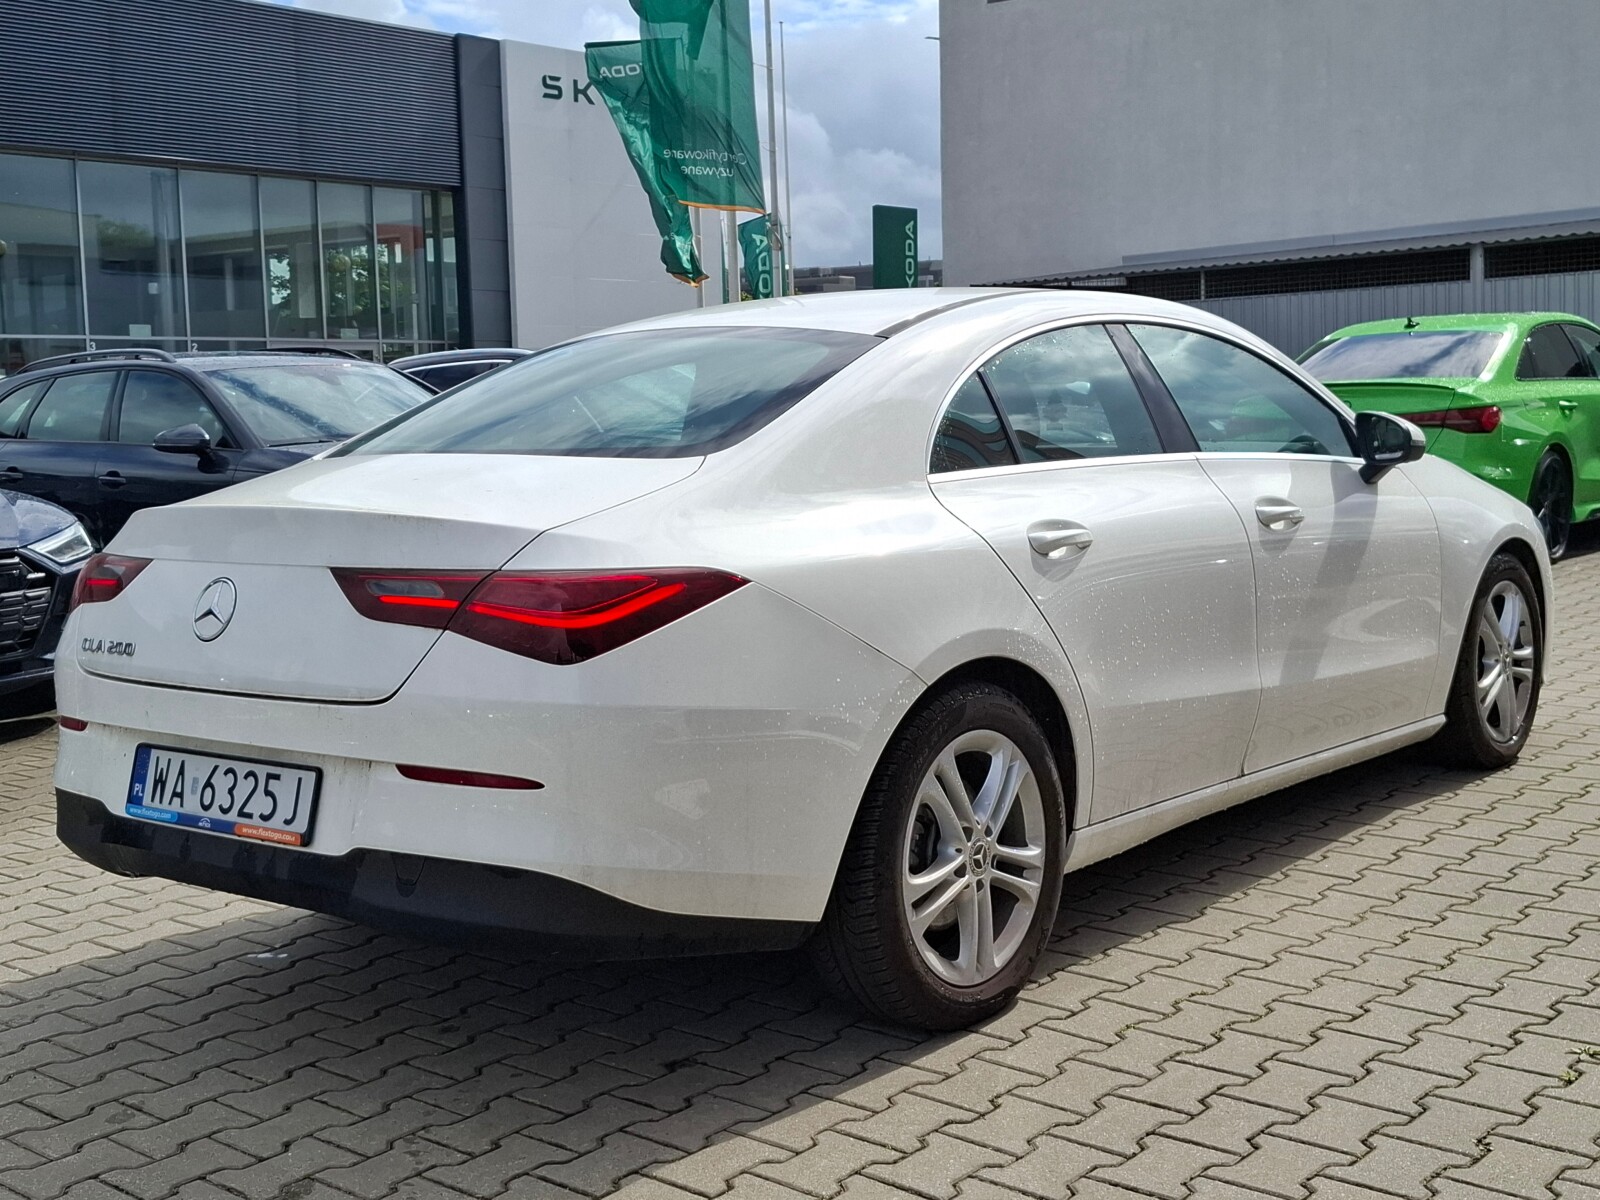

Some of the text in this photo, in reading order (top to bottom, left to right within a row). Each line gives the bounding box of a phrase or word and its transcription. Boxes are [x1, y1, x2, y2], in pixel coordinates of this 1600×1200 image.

[905, 220, 915, 289] KODA
[89, 341, 97, 351] 3
[191, 343, 198, 352] 2
[81, 637, 136, 657] CLA 200
[133, 782, 143, 797] PL
[150, 755, 303, 826] WA 6325J
[242, 826, 296, 842] www.flextogo.com
